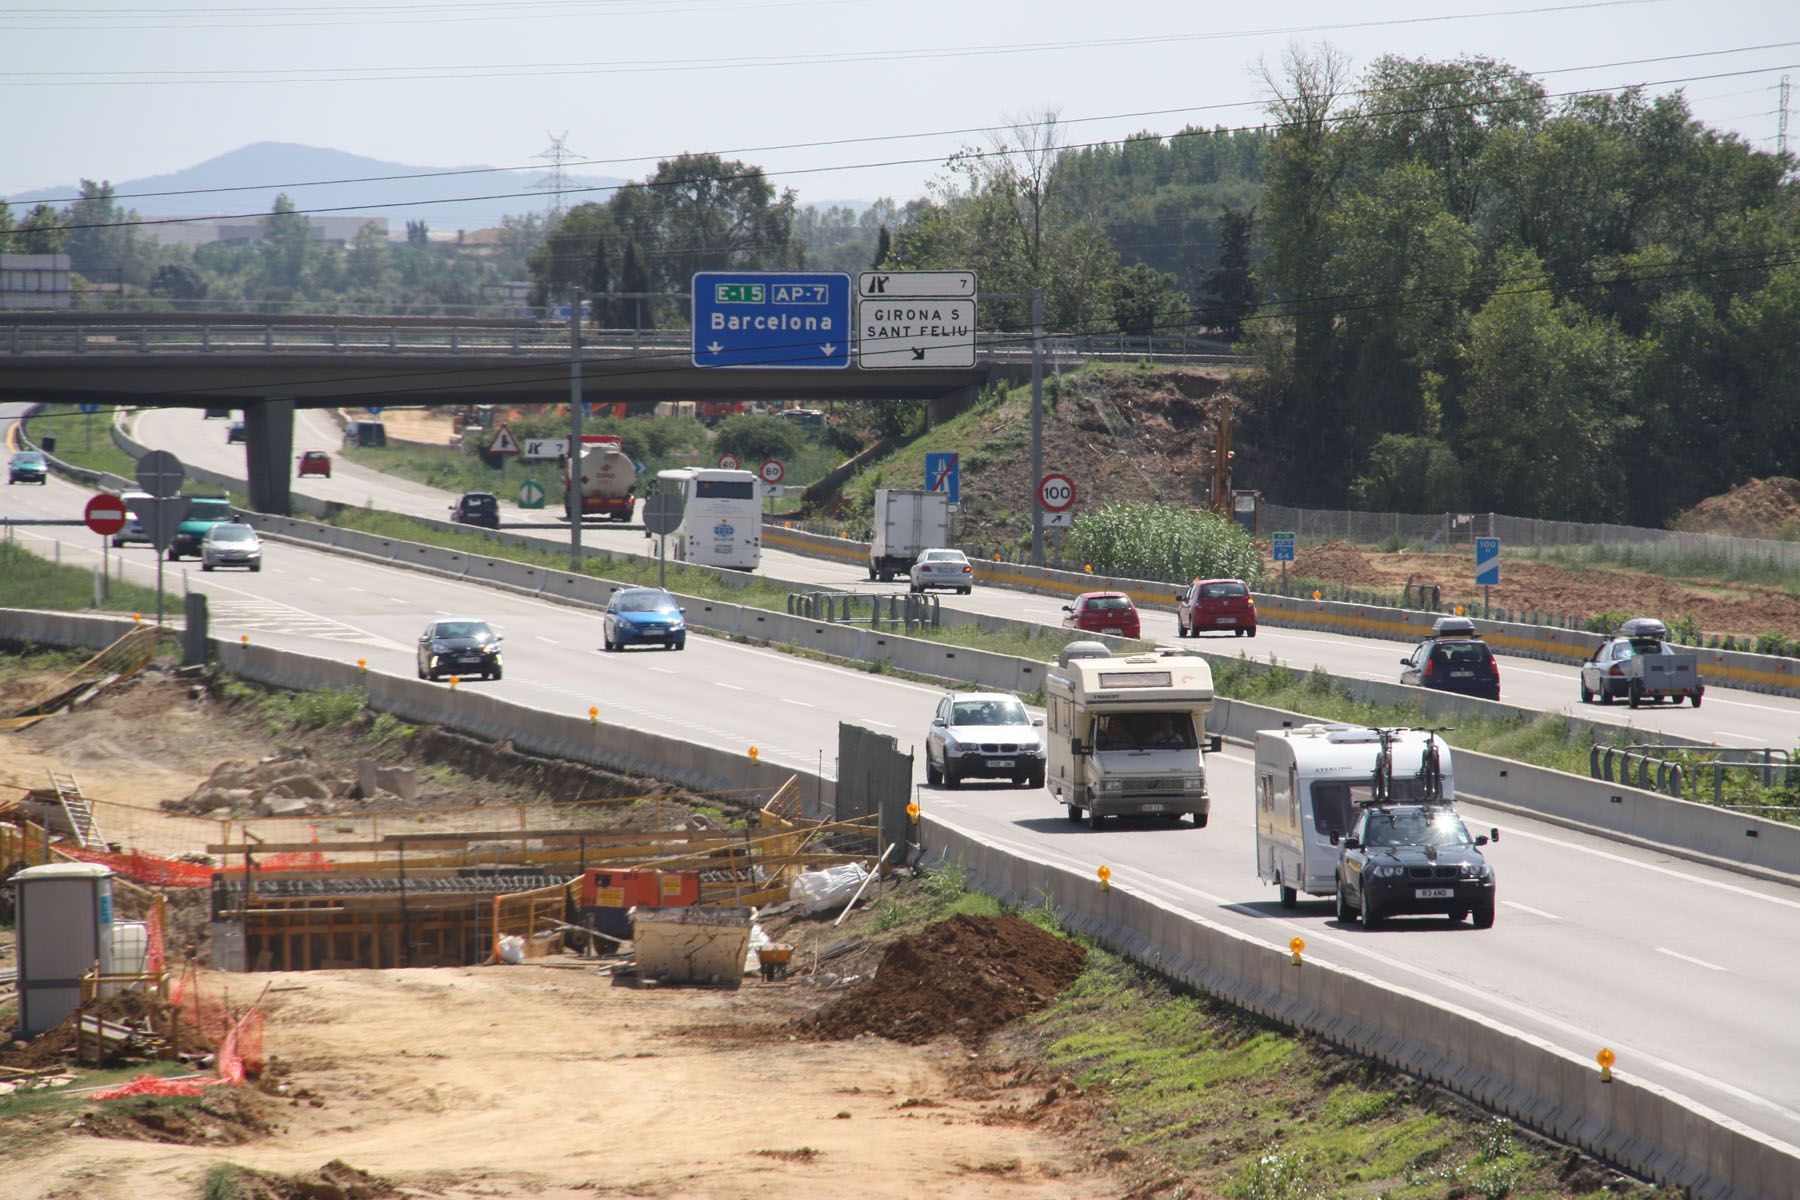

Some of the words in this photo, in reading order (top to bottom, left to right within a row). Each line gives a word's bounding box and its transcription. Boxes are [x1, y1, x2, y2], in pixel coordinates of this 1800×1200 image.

[960, 279, 968, 289] 7
[717, 286, 763, 301] E-15
[775, 286, 826, 301] AP-7
[711, 312, 832, 331] Barcelona
[874, 308, 942, 321] GIRONA
[951, 308, 960, 321] S
[867, 325, 911, 337] SANT
[920, 325, 968, 337] FELIU
[1044, 486, 1070, 500] 100
